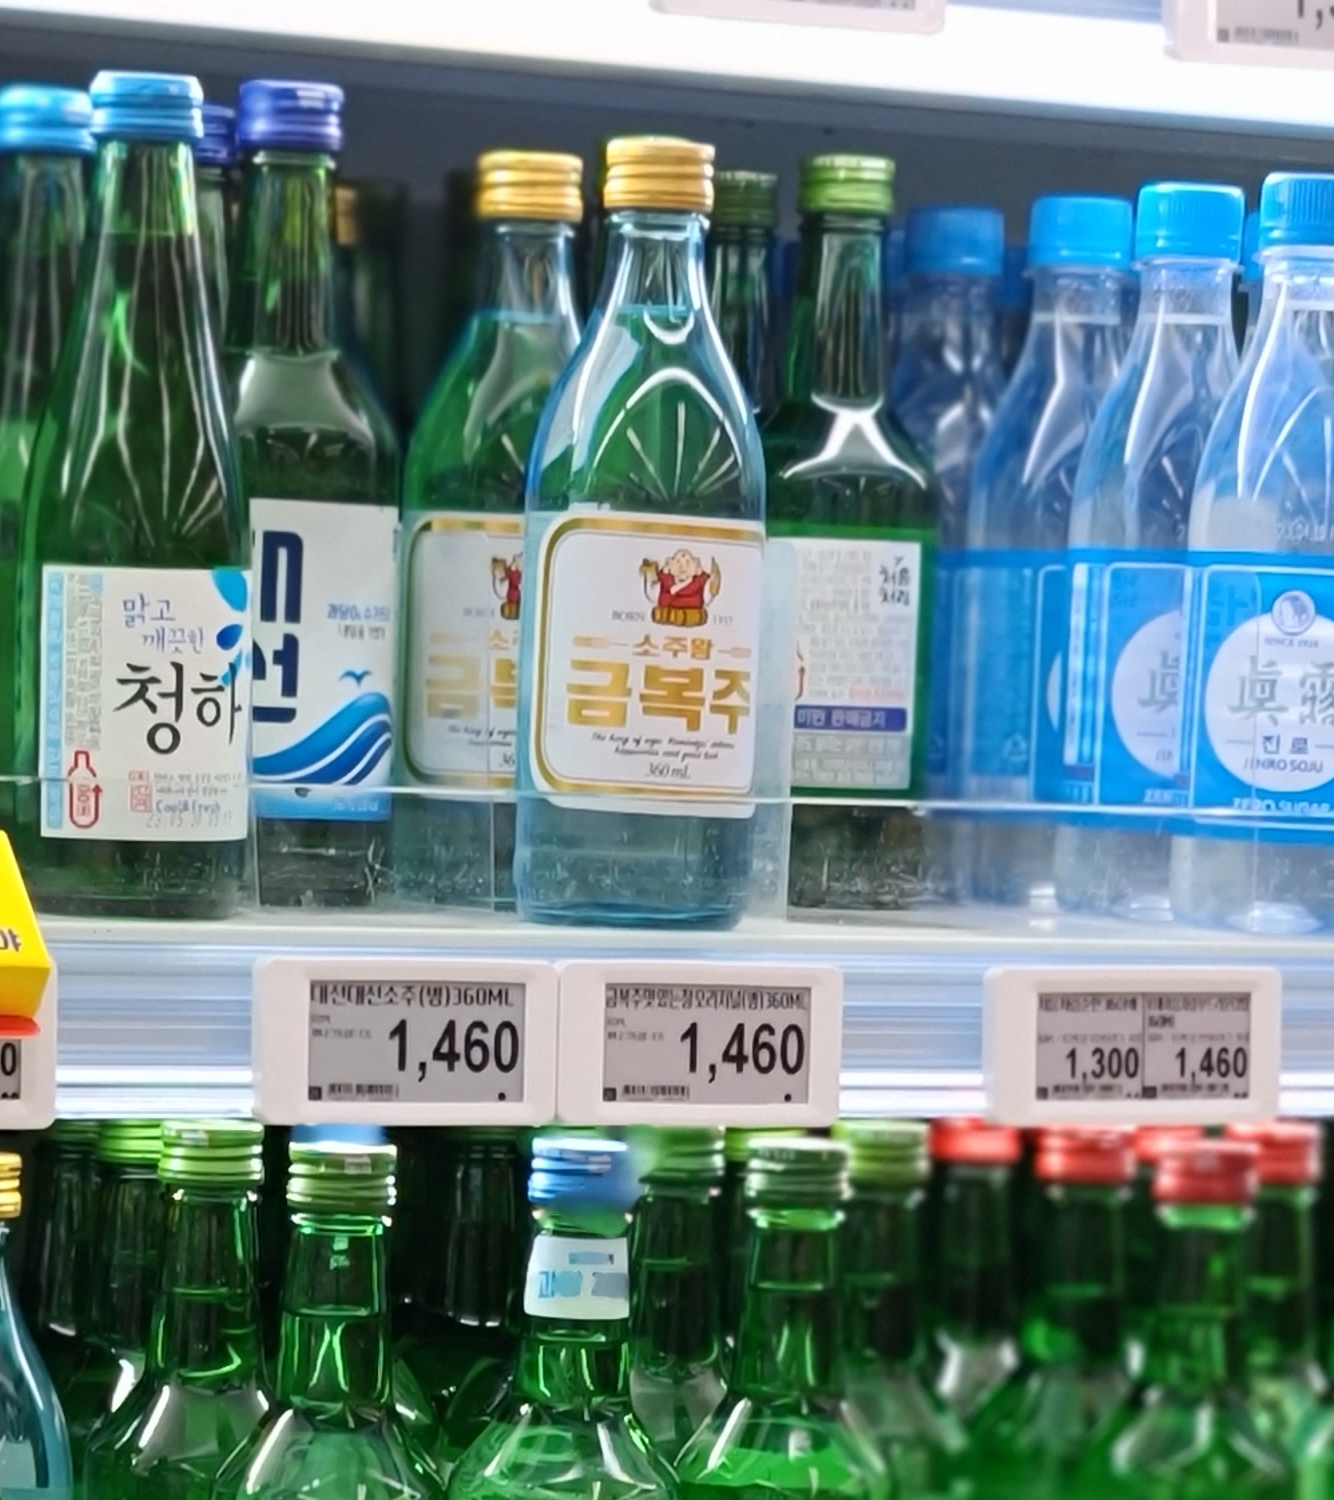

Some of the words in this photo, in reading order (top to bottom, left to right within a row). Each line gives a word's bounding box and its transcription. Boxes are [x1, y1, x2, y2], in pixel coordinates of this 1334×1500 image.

[121, 593, 177, 627] 맑고
[141, 626, 205, 654] 깨끗한
[113, 660, 243, 755] 청하
[566, 658, 751, 736] 금복주
[1261, 734, 1310, 755] 진로
[388, 1018, 520, 1083] 1,460
[678, 1021, 805, 1083] 1,460
[1066, 1046, 1140, 1086] 1,300
[1175, 1046, 1249, 1088] 1,460
